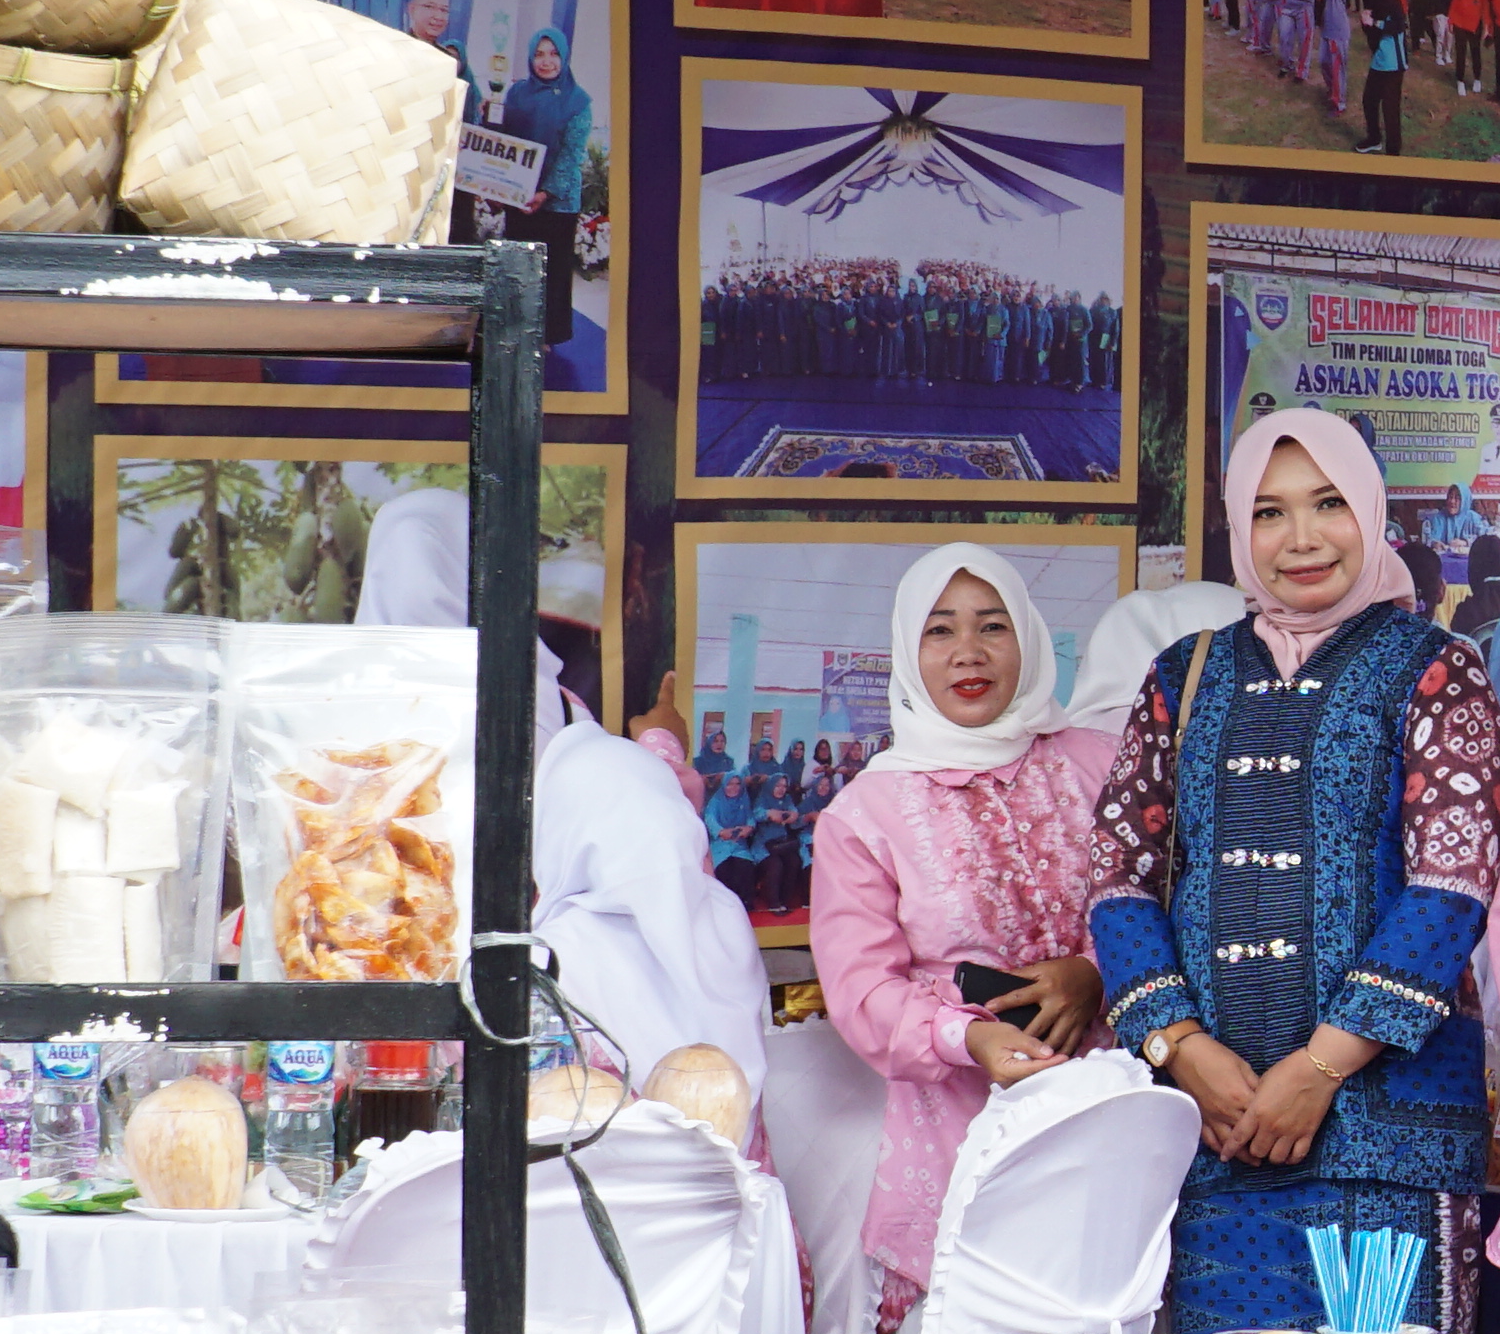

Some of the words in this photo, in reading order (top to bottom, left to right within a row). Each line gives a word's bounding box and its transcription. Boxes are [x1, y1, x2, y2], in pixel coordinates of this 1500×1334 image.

[461, 131, 517, 163] JUARA
[1308, 292, 1419, 347] SELAMAT
[1331, 341, 1357, 361] TIM
[1360, 343, 1407, 364] PENILAI
[1410, 347, 1452, 366] LOMBA
[1455, 350, 1487, 368] TOGA
[1294, 362, 1382, 398] ASMAN
[1384, 368, 1461, 401] ASOKA
[1386, 410, 1439, 433] TANJUNG
[1440, 413, 1481, 434] AGUNG
[47, 1044, 90, 1062] AQUA
[283, 1048, 326, 1066] AQUA
